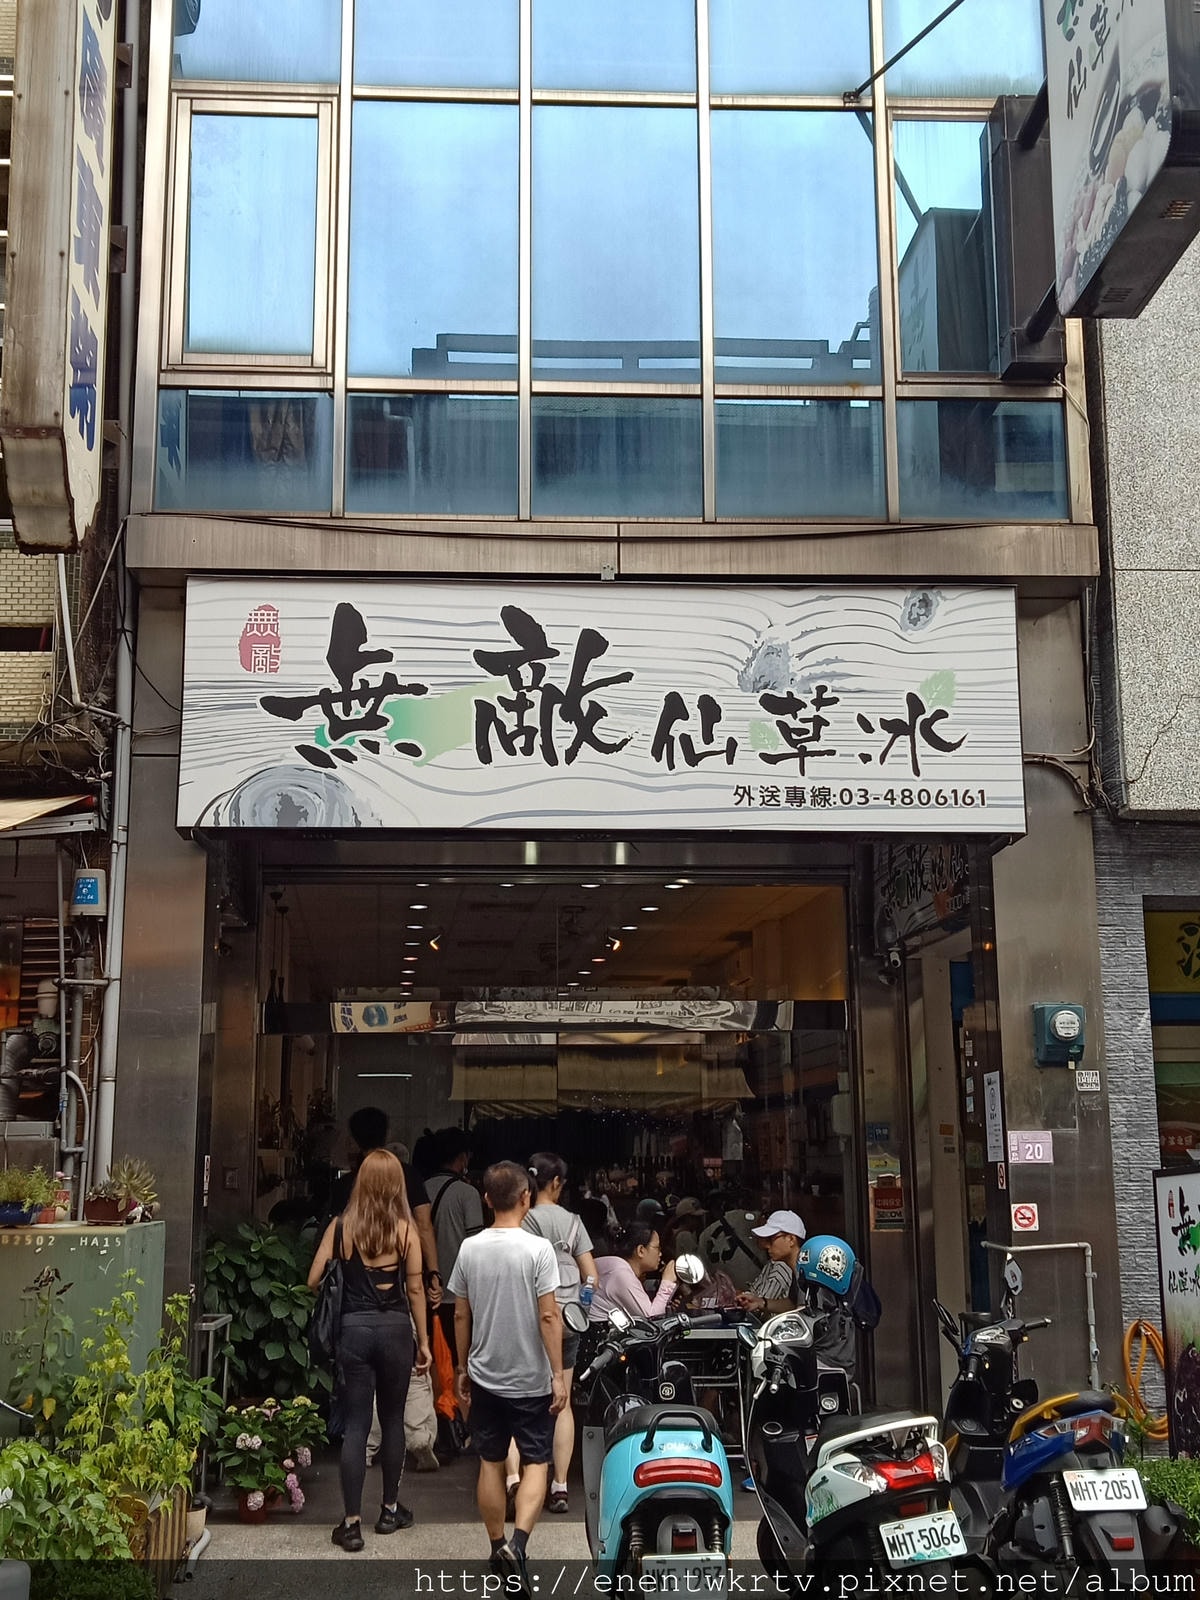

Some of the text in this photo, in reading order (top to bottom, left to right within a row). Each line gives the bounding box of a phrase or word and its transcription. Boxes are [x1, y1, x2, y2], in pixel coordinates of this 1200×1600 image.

[260, 602, 967, 777] 無敵仙草冰
[1025, 1143, 1043, 1160] 20
